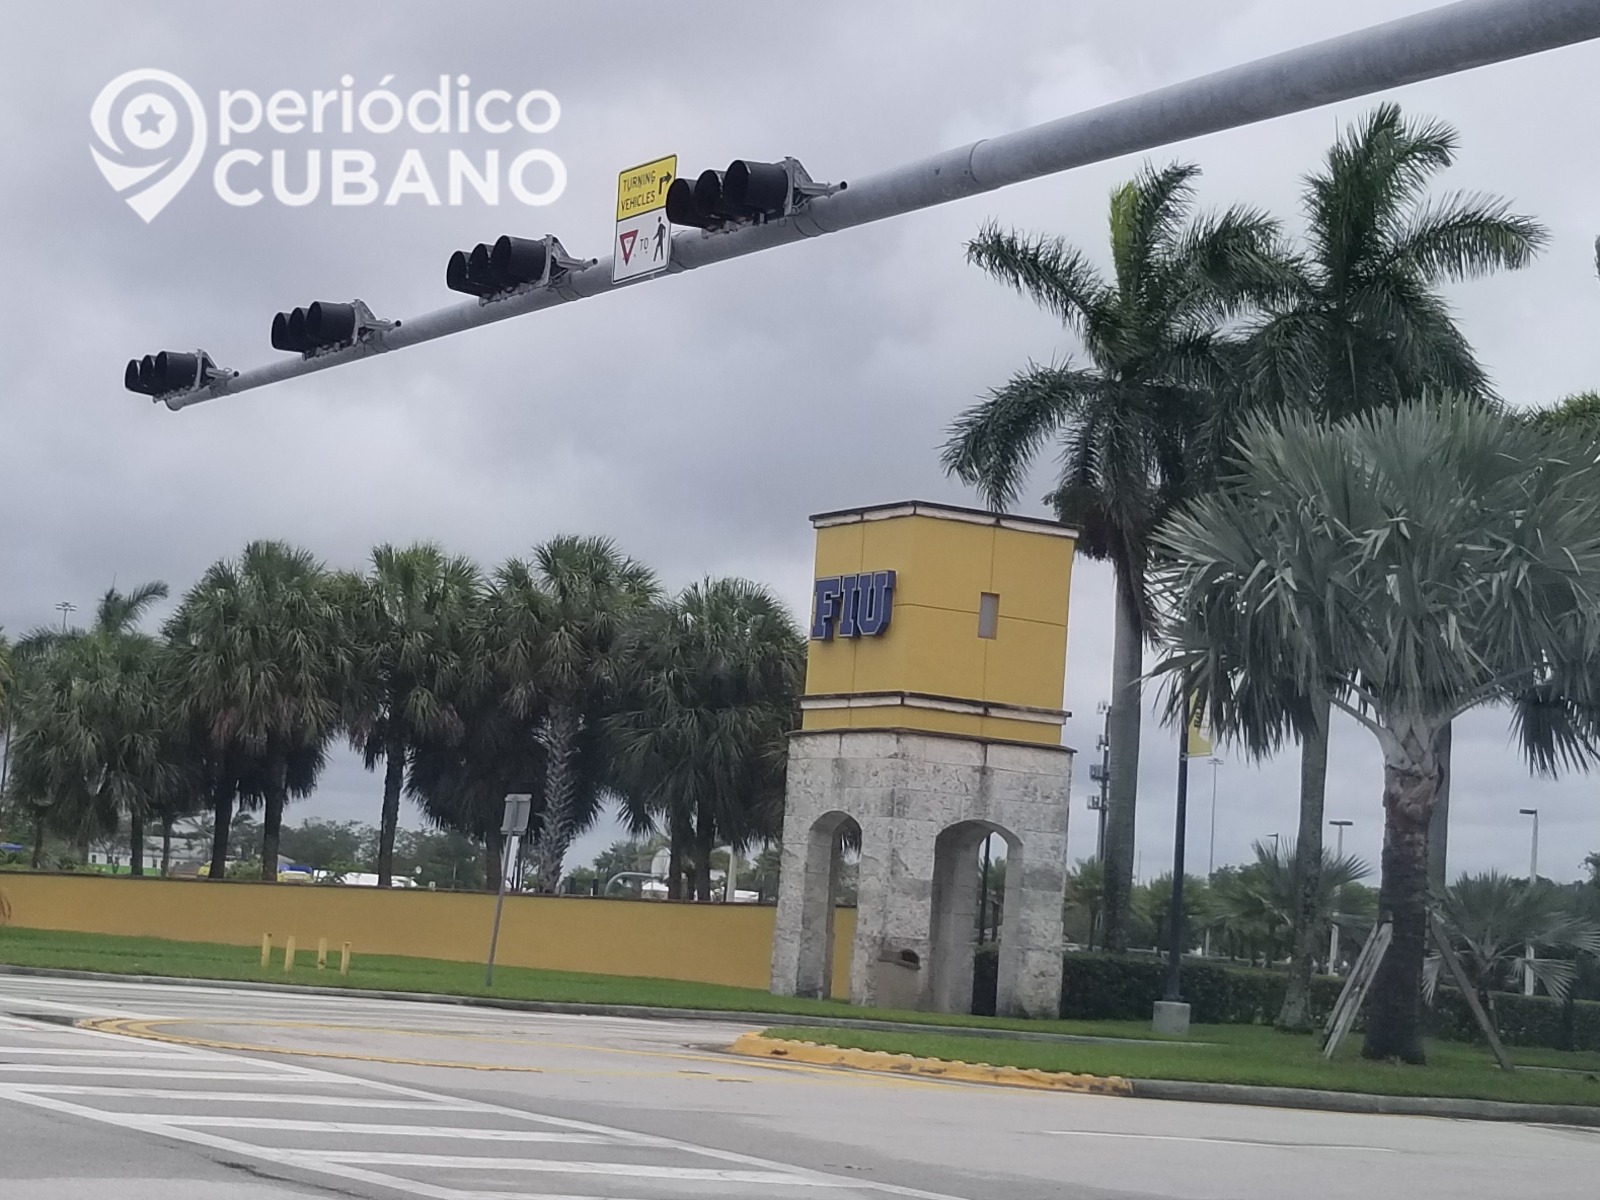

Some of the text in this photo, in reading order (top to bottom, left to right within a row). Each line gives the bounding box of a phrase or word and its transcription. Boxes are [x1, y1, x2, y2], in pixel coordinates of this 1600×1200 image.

[623, 170, 656, 192] TURNING
[621, 190, 655, 211] VEHICLES
[640, 237, 649, 251] TO
[811, 570, 896, 641] FIU
